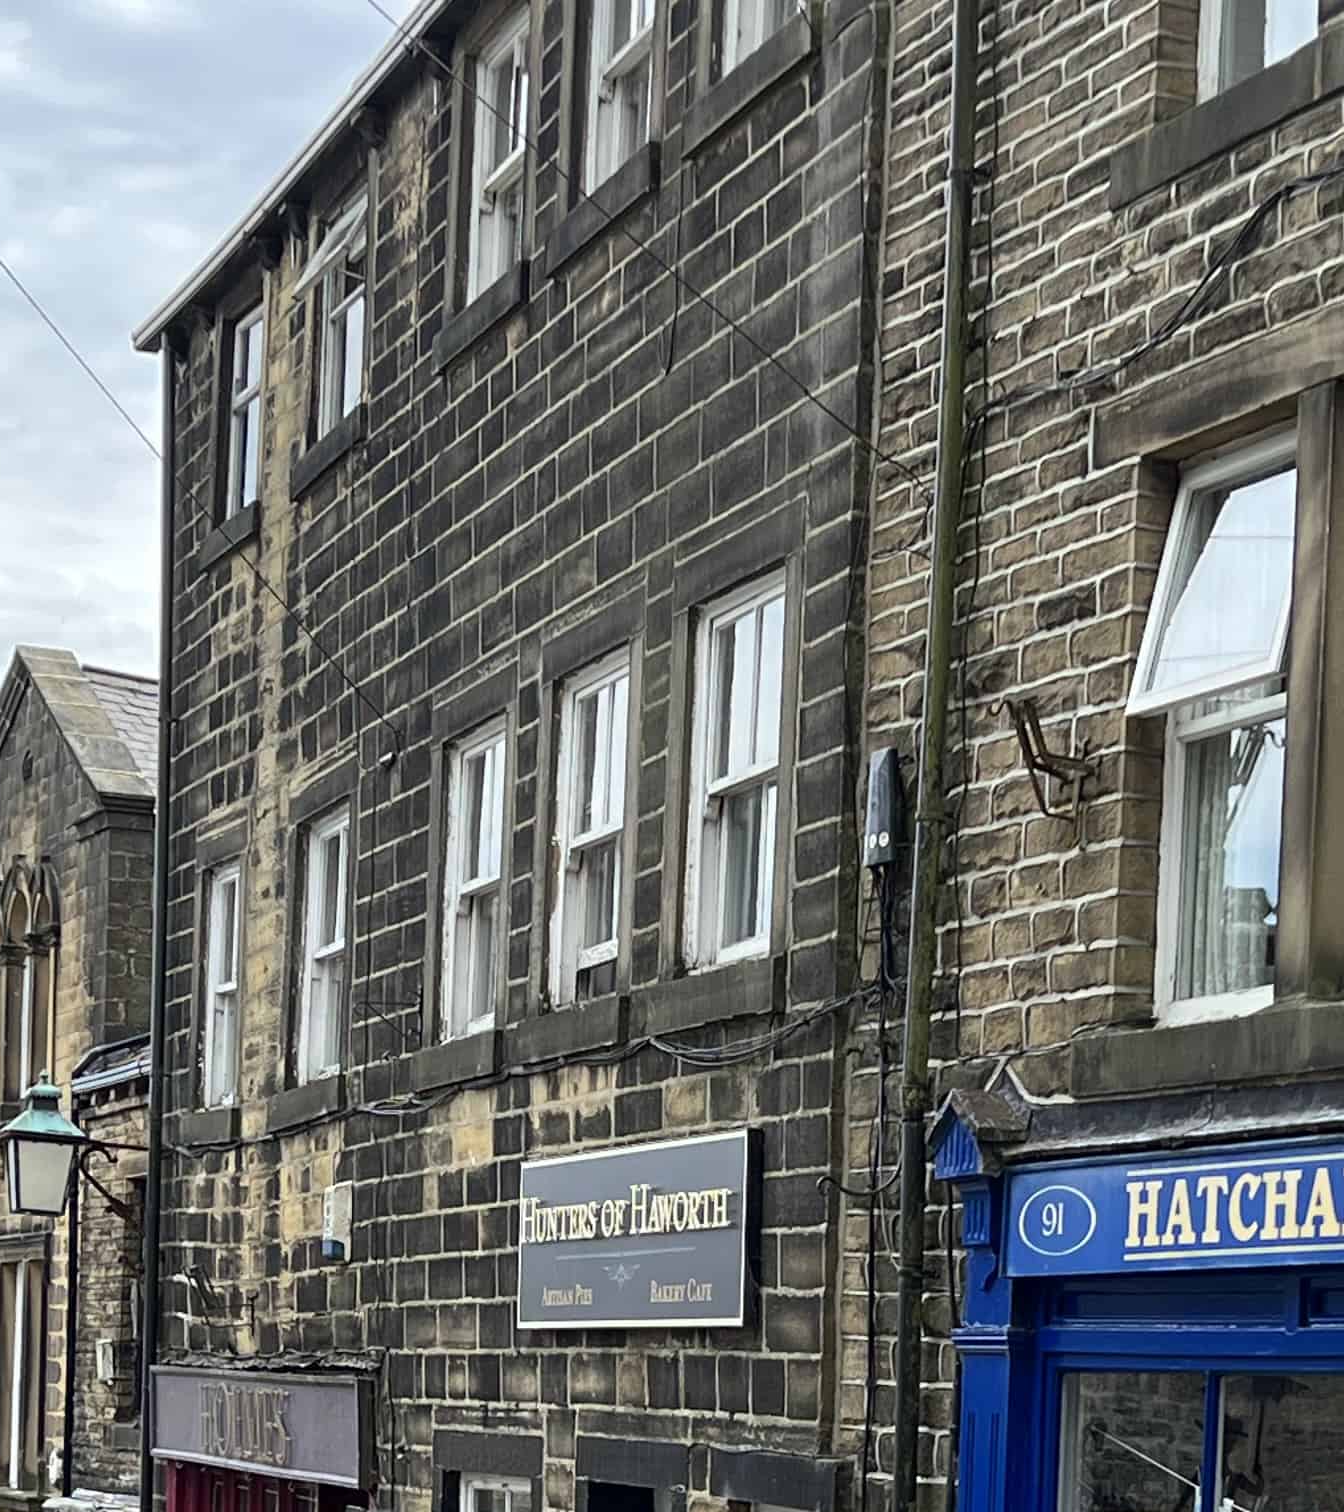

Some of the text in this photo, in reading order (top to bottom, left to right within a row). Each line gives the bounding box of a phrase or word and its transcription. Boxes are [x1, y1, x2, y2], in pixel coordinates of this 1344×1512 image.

[521, 1183, 734, 1244] HUNTERS OF HAWORTH
[1042, 1201, 1064, 1238] 91
[650, 1279, 687, 1303] BAKERY
